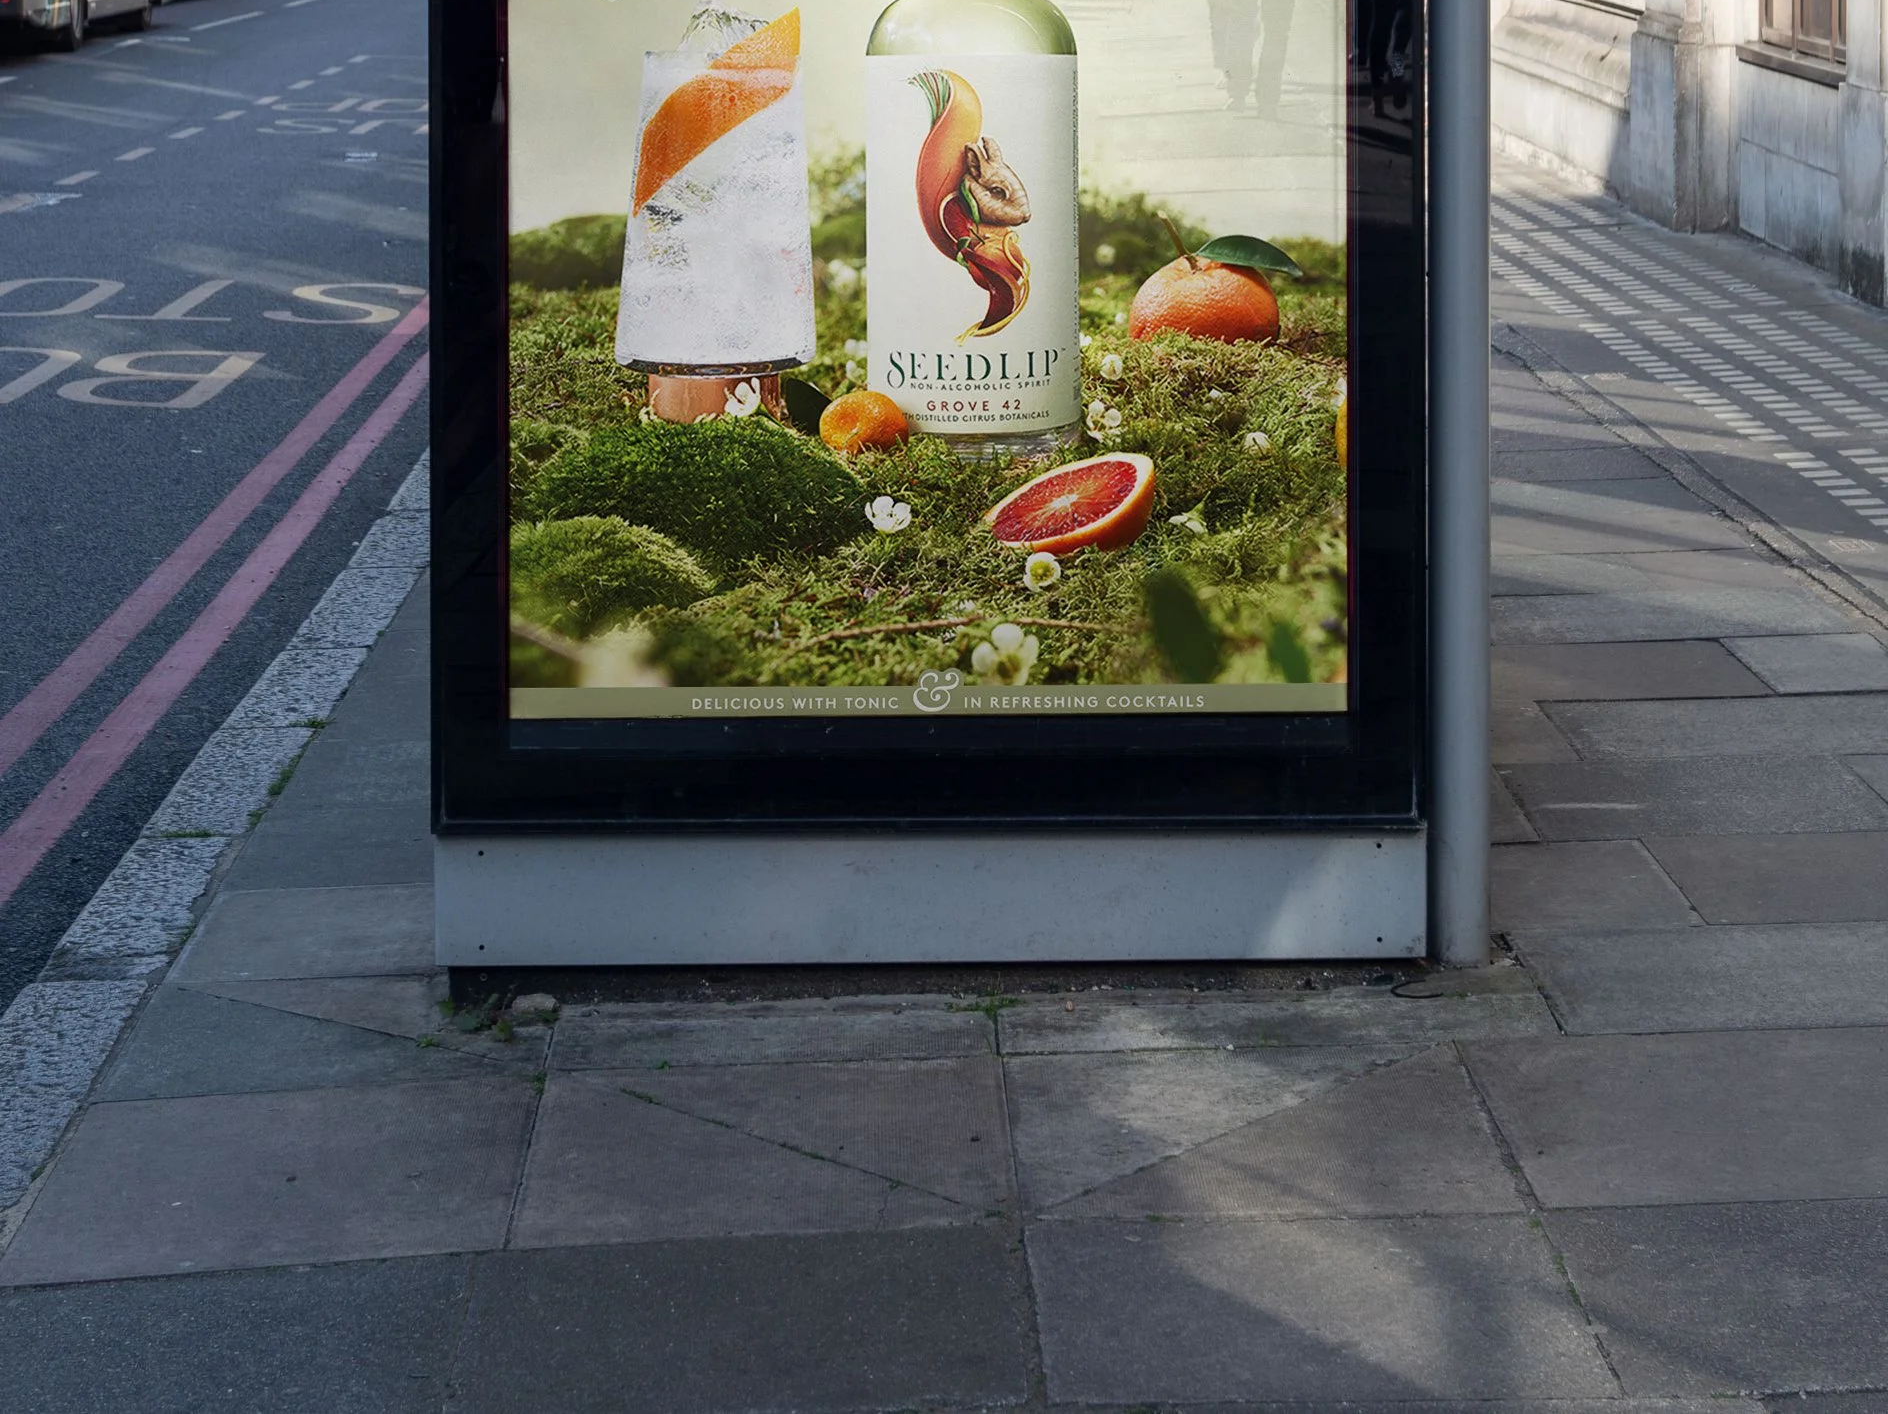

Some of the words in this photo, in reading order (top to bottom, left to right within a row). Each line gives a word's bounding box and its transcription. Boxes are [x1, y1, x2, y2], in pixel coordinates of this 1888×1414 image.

[887, 349, 1059, 389] SEEDLIP
[910, 382, 1011, 391] NON-ALCOHOLIC
[1017, 379, 1051, 390] SPIRIT
[926, 400, 990, 413] GROVE
[1002, 399, 1022, 411] 42
[915, 413, 959, 423] DISTILLED
[962, 413, 996, 423] CITRUS
[999, 410, 1050, 422] BOTANICALS
[692, 697, 785, 710] DELICIOUS
[792, 697, 837, 710] WITH
[844, 696, 899, 710] TONIC
[964, 696, 981, 709] IN
[990, 696, 1098, 709] REFRESHING
[1106, 694, 1205, 708] COCKTAILS
